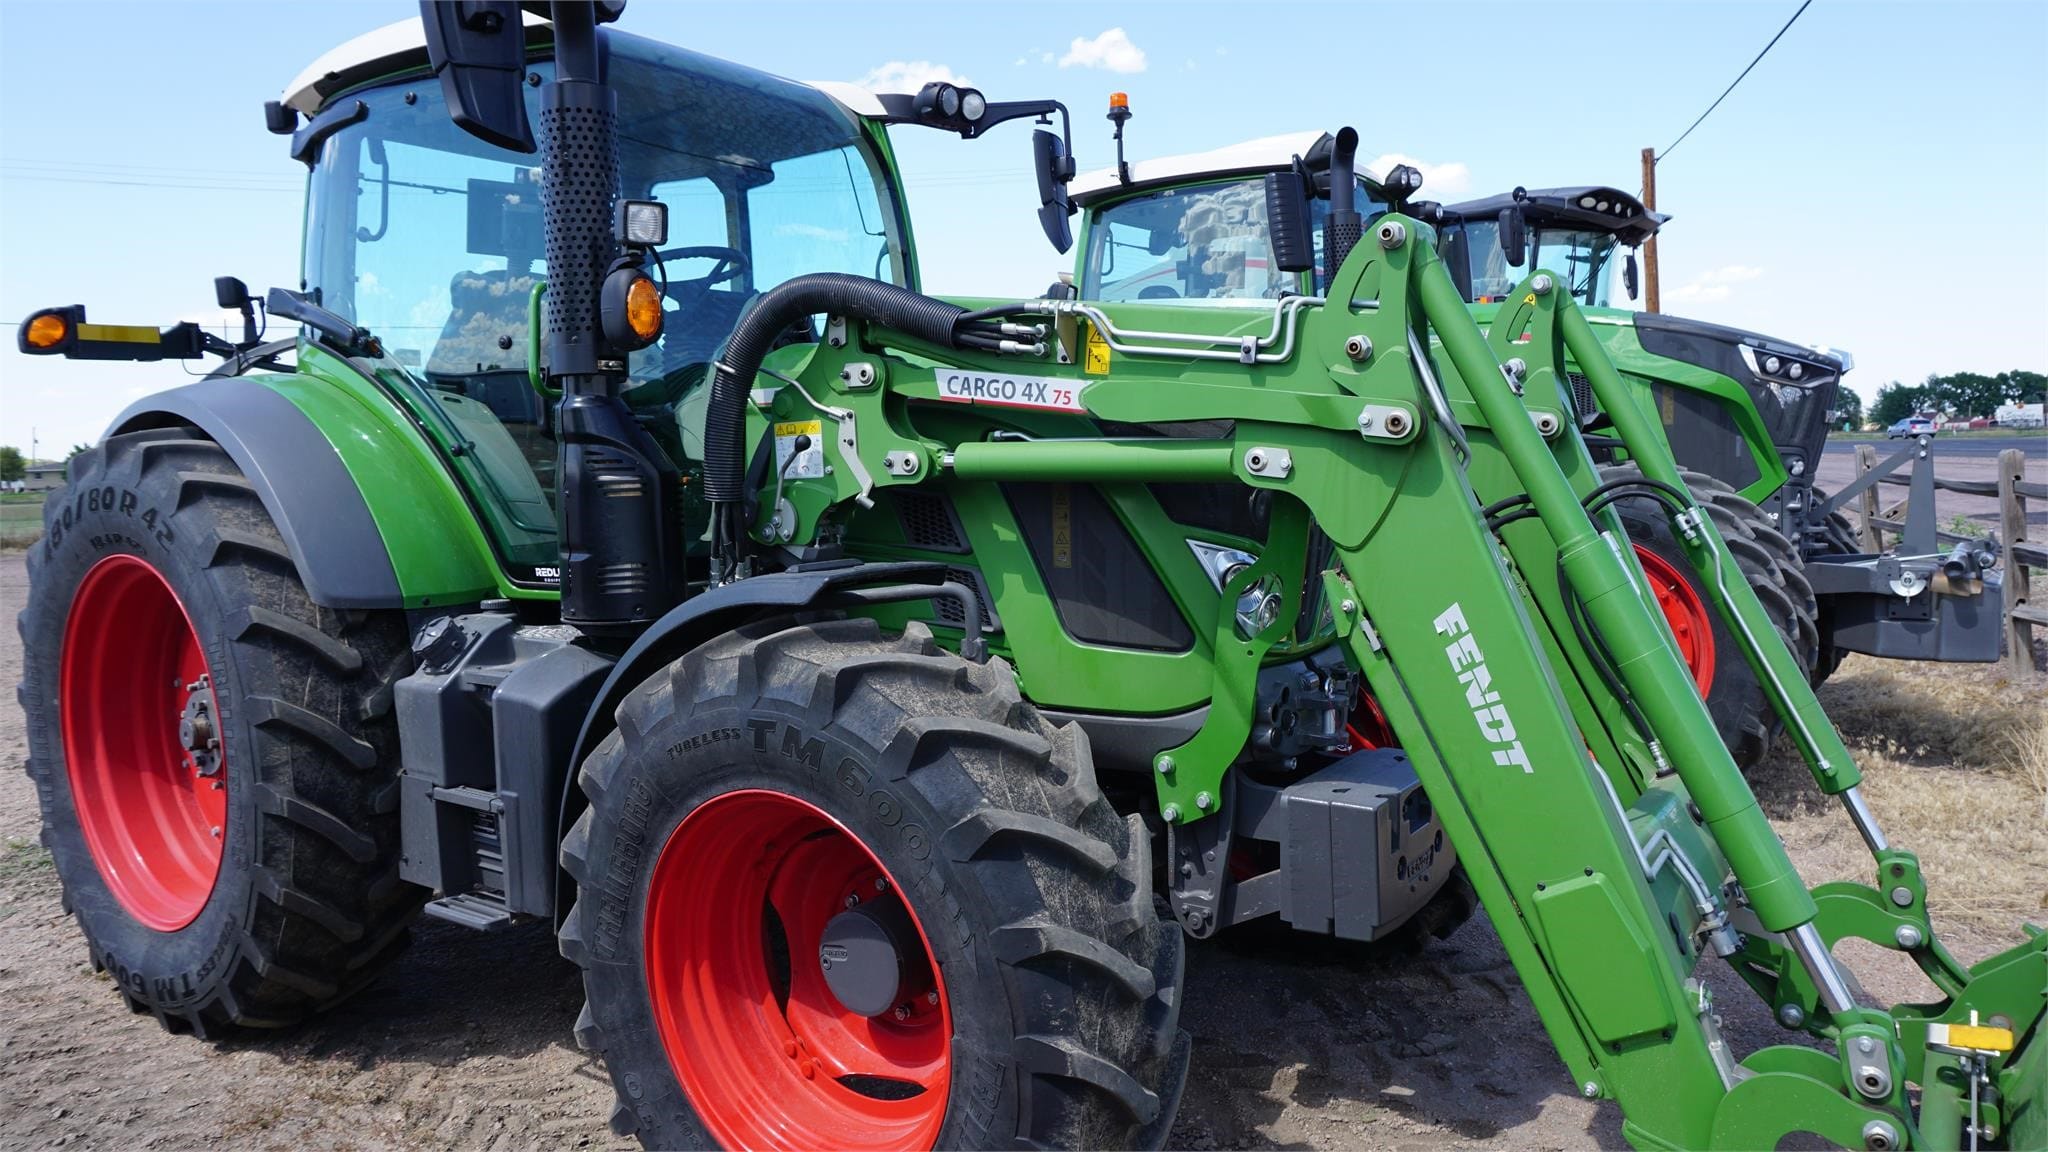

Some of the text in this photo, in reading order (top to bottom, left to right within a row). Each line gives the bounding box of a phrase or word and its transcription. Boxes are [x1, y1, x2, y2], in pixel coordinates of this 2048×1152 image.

[947, 375, 1072, 406] CARGO 4X 75
[1433, 602, 1534, 773] FENDT
[667, 719, 932, 861] TUBELESS TM 600
[592, 776, 652, 960] TRELLEBORG
[153, 972, 198, 1001] TM
